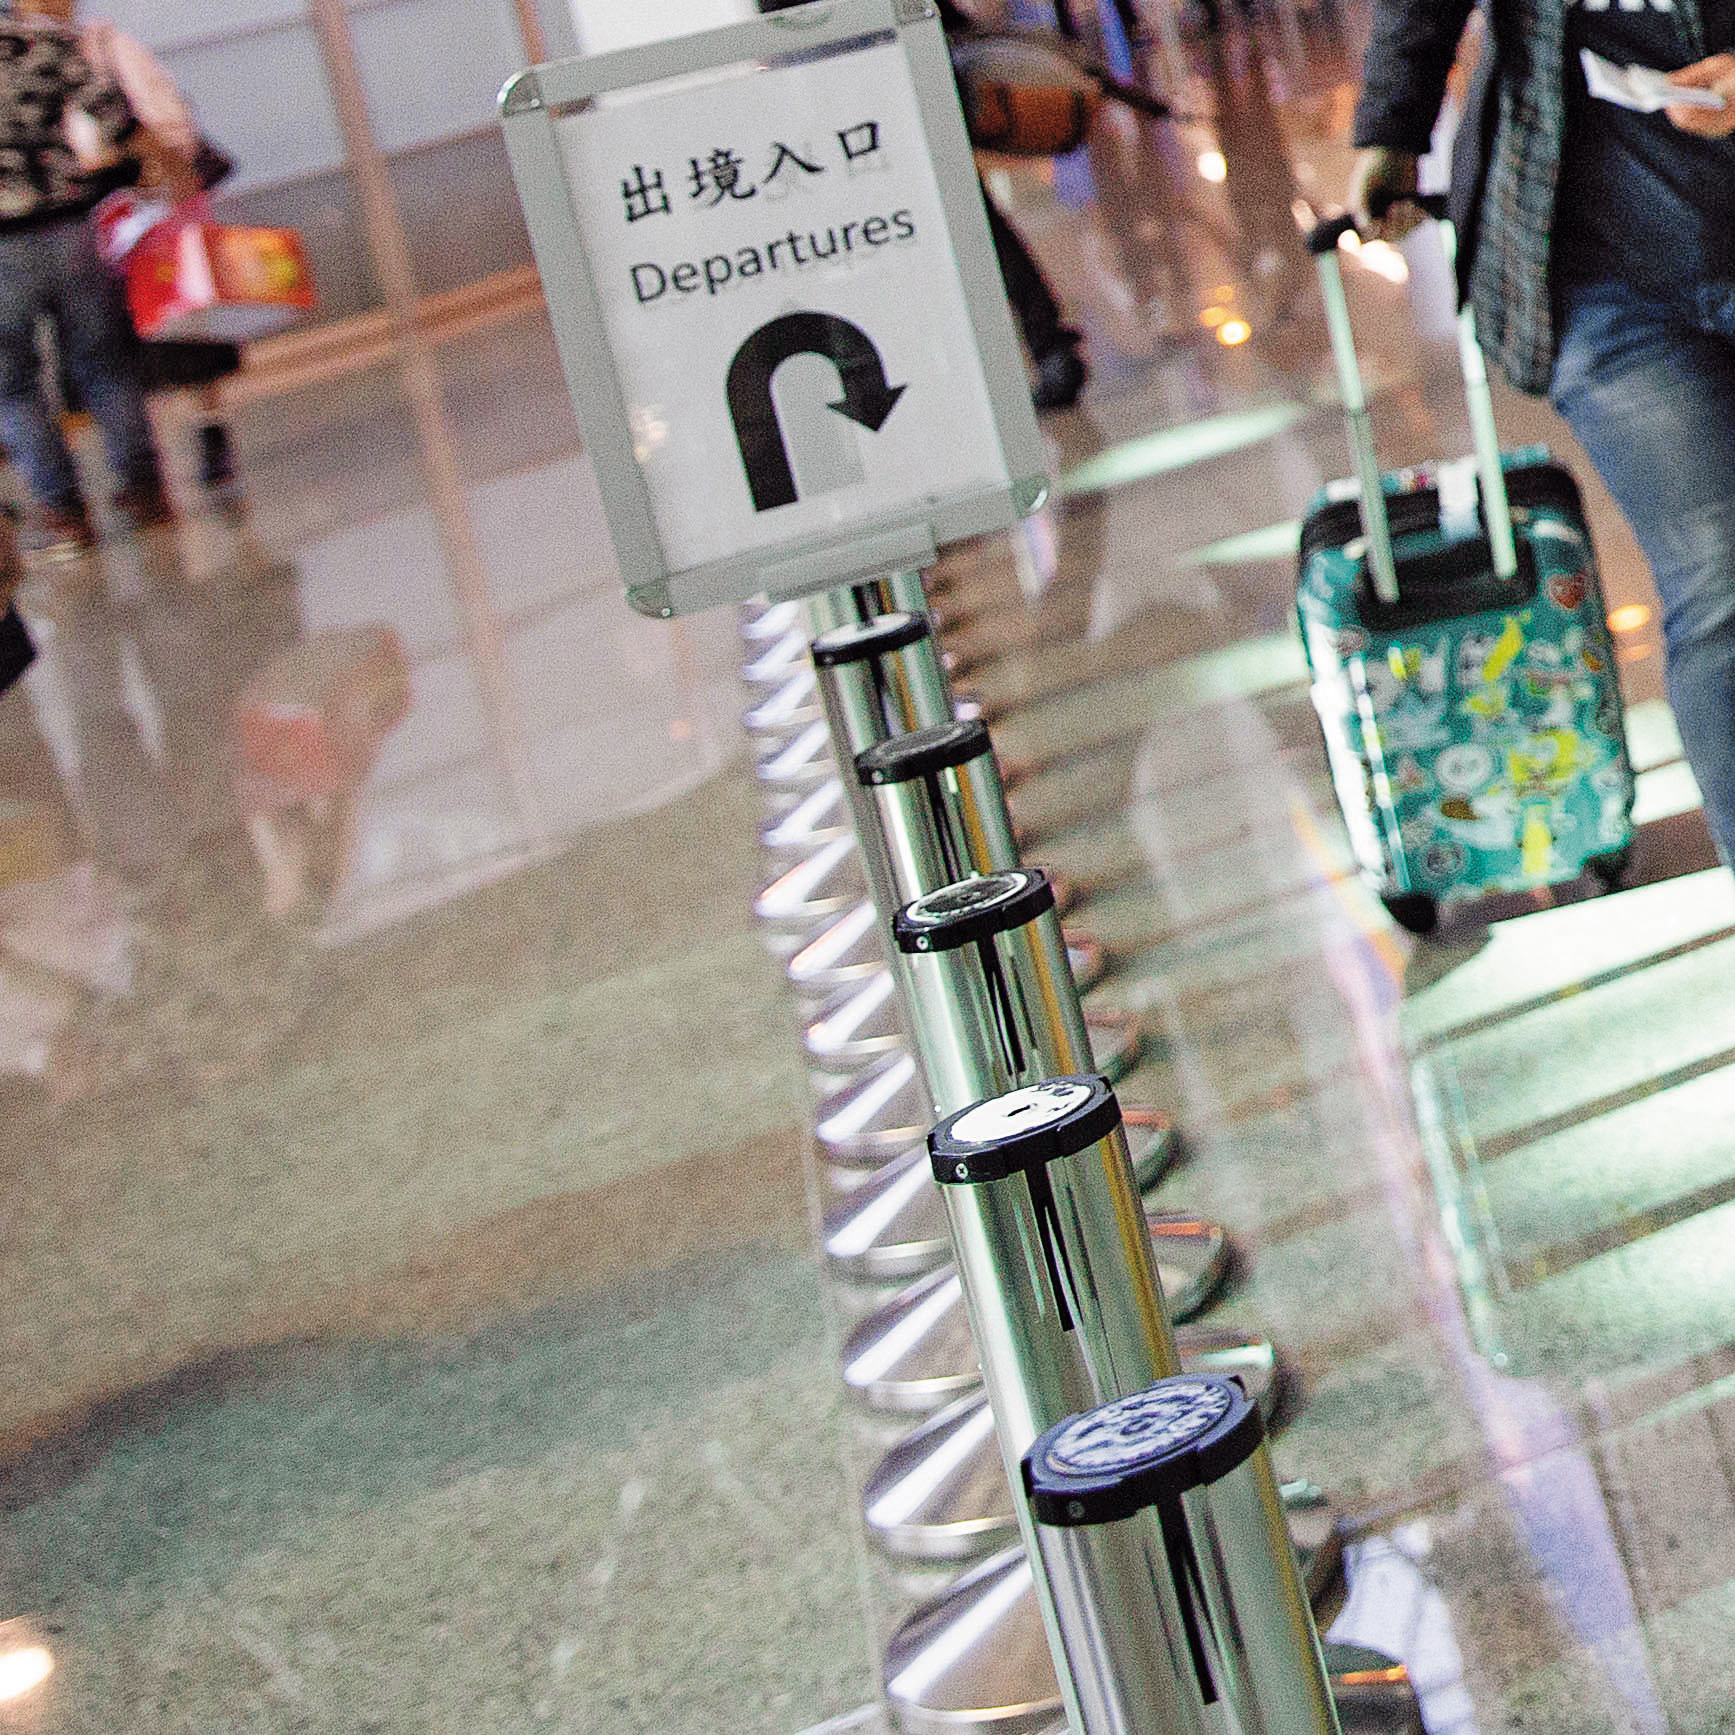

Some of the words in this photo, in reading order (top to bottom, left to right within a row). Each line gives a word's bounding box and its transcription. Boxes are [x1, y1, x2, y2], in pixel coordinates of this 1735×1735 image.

[619, 120, 884, 226] 出境入口
[630, 205, 916, 305] Departures
